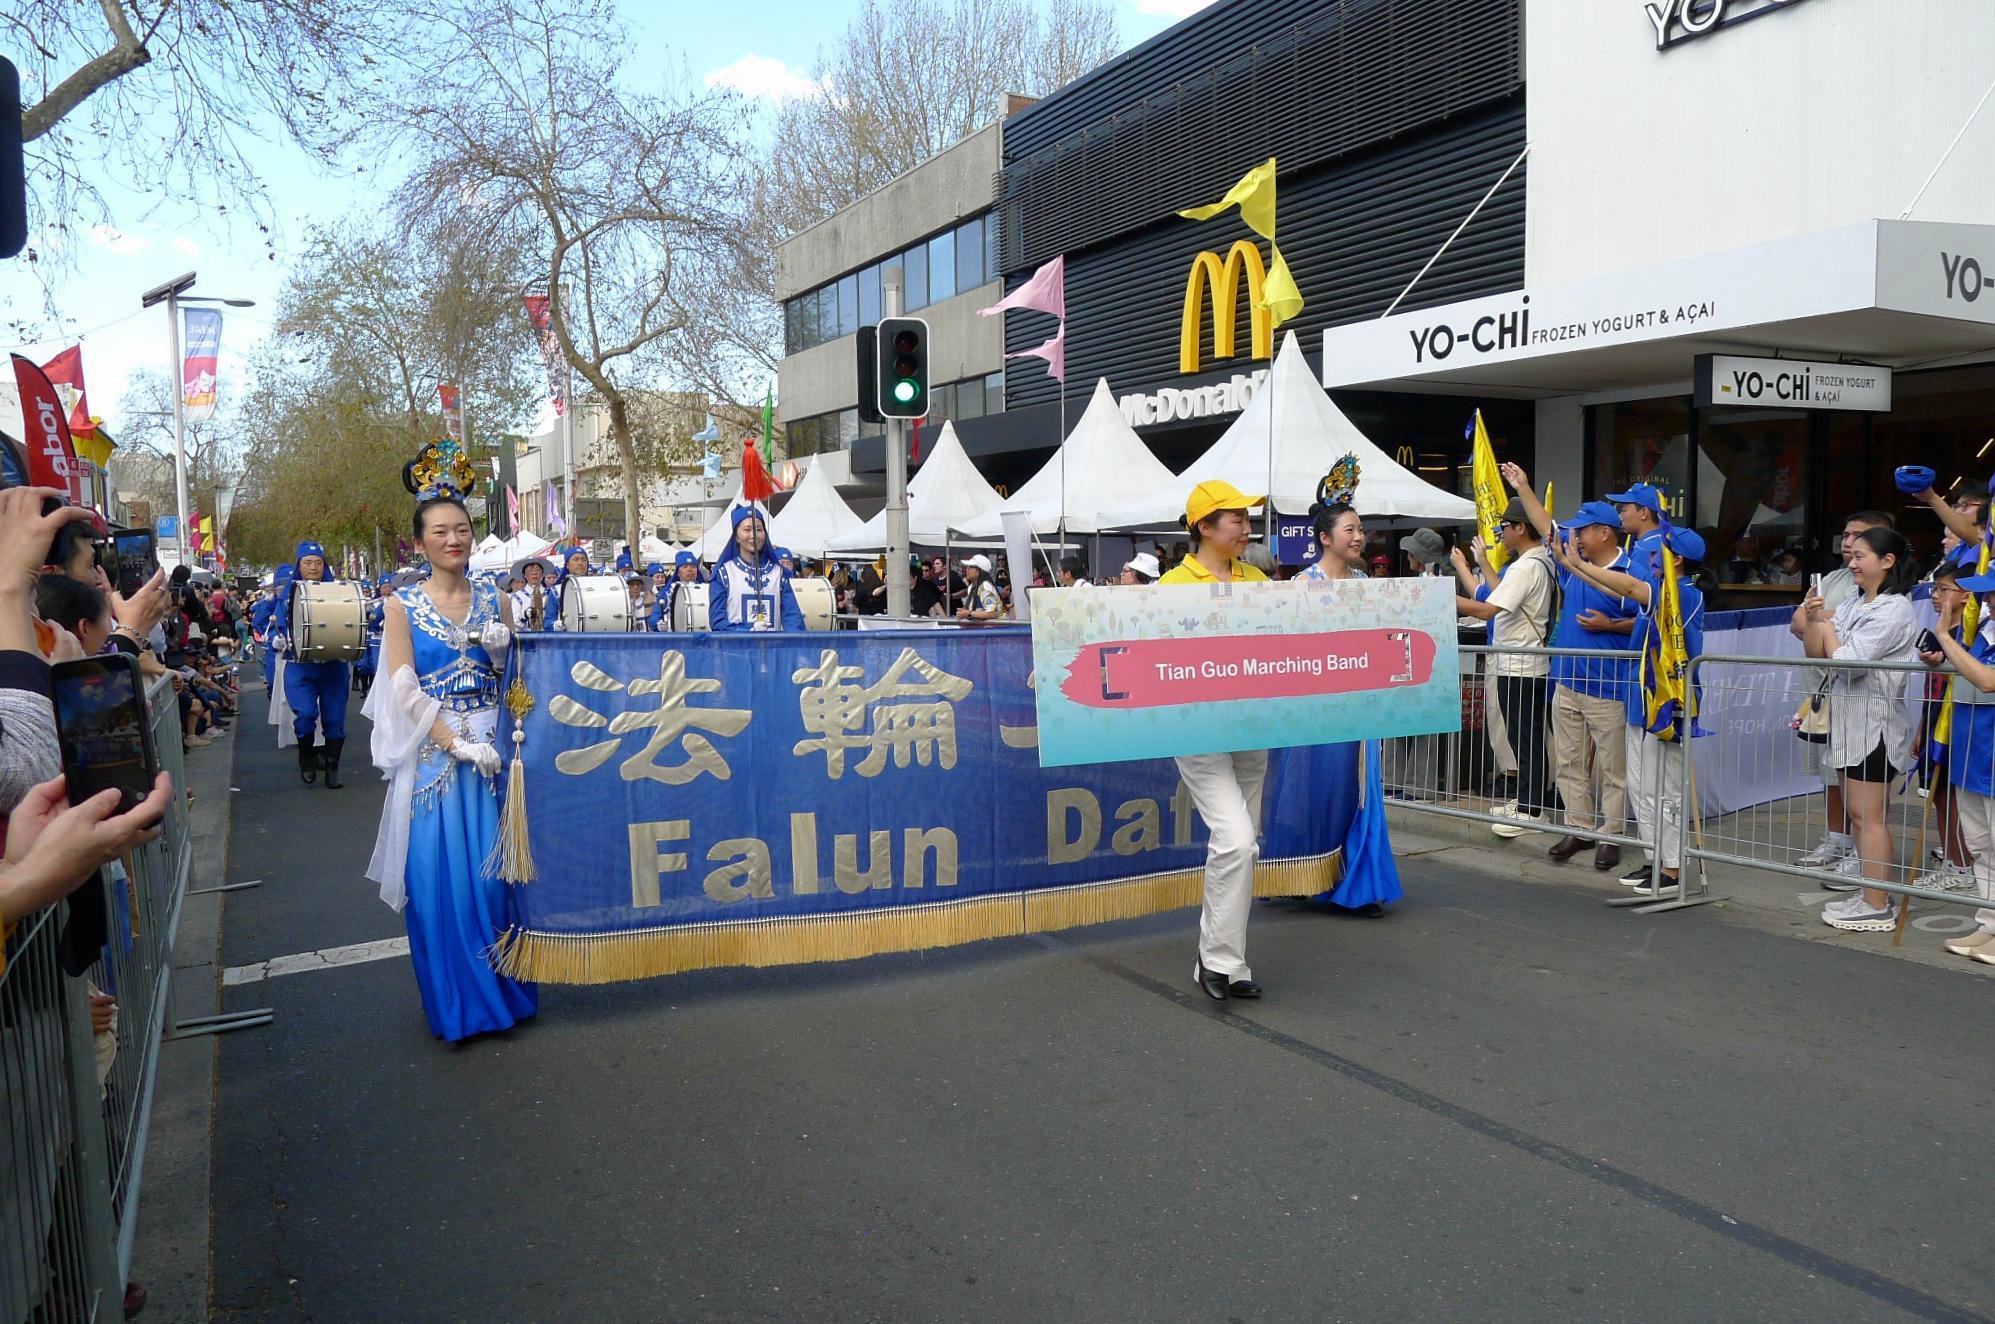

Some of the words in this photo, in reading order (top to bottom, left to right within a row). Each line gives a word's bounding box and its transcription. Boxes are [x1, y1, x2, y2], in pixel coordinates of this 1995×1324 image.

[1410, 295, 1530, 363] YO-CHi
[1532, 323, 1587, 345] FROZEN
[1593, 311, 1656, 334] YOGURT
[1659, 309, 1670, 324] &
[1733, 367, 1810, 401] YO-CHi
[1815, 375, 1844, 387] FROZEN
[1846, 377, 1876, 390] YOGURT
[1814, 393, 1821, 402] &
[1630, 474, 1671, 486] ORIGINAL
[1281, 525, 1306, 538] GIFT
[1155, 662, 1197, 682] Tian
[1200, 659, 1239, 678] Guo
[1243, 655, 1322, 679] Marching
[1327, 652, 1368, 671] Band
[549, 646, 1037, 785] 法輪
[627, 812, 959, 909] Falun
[1047, 777, 1215, 866] Daf
